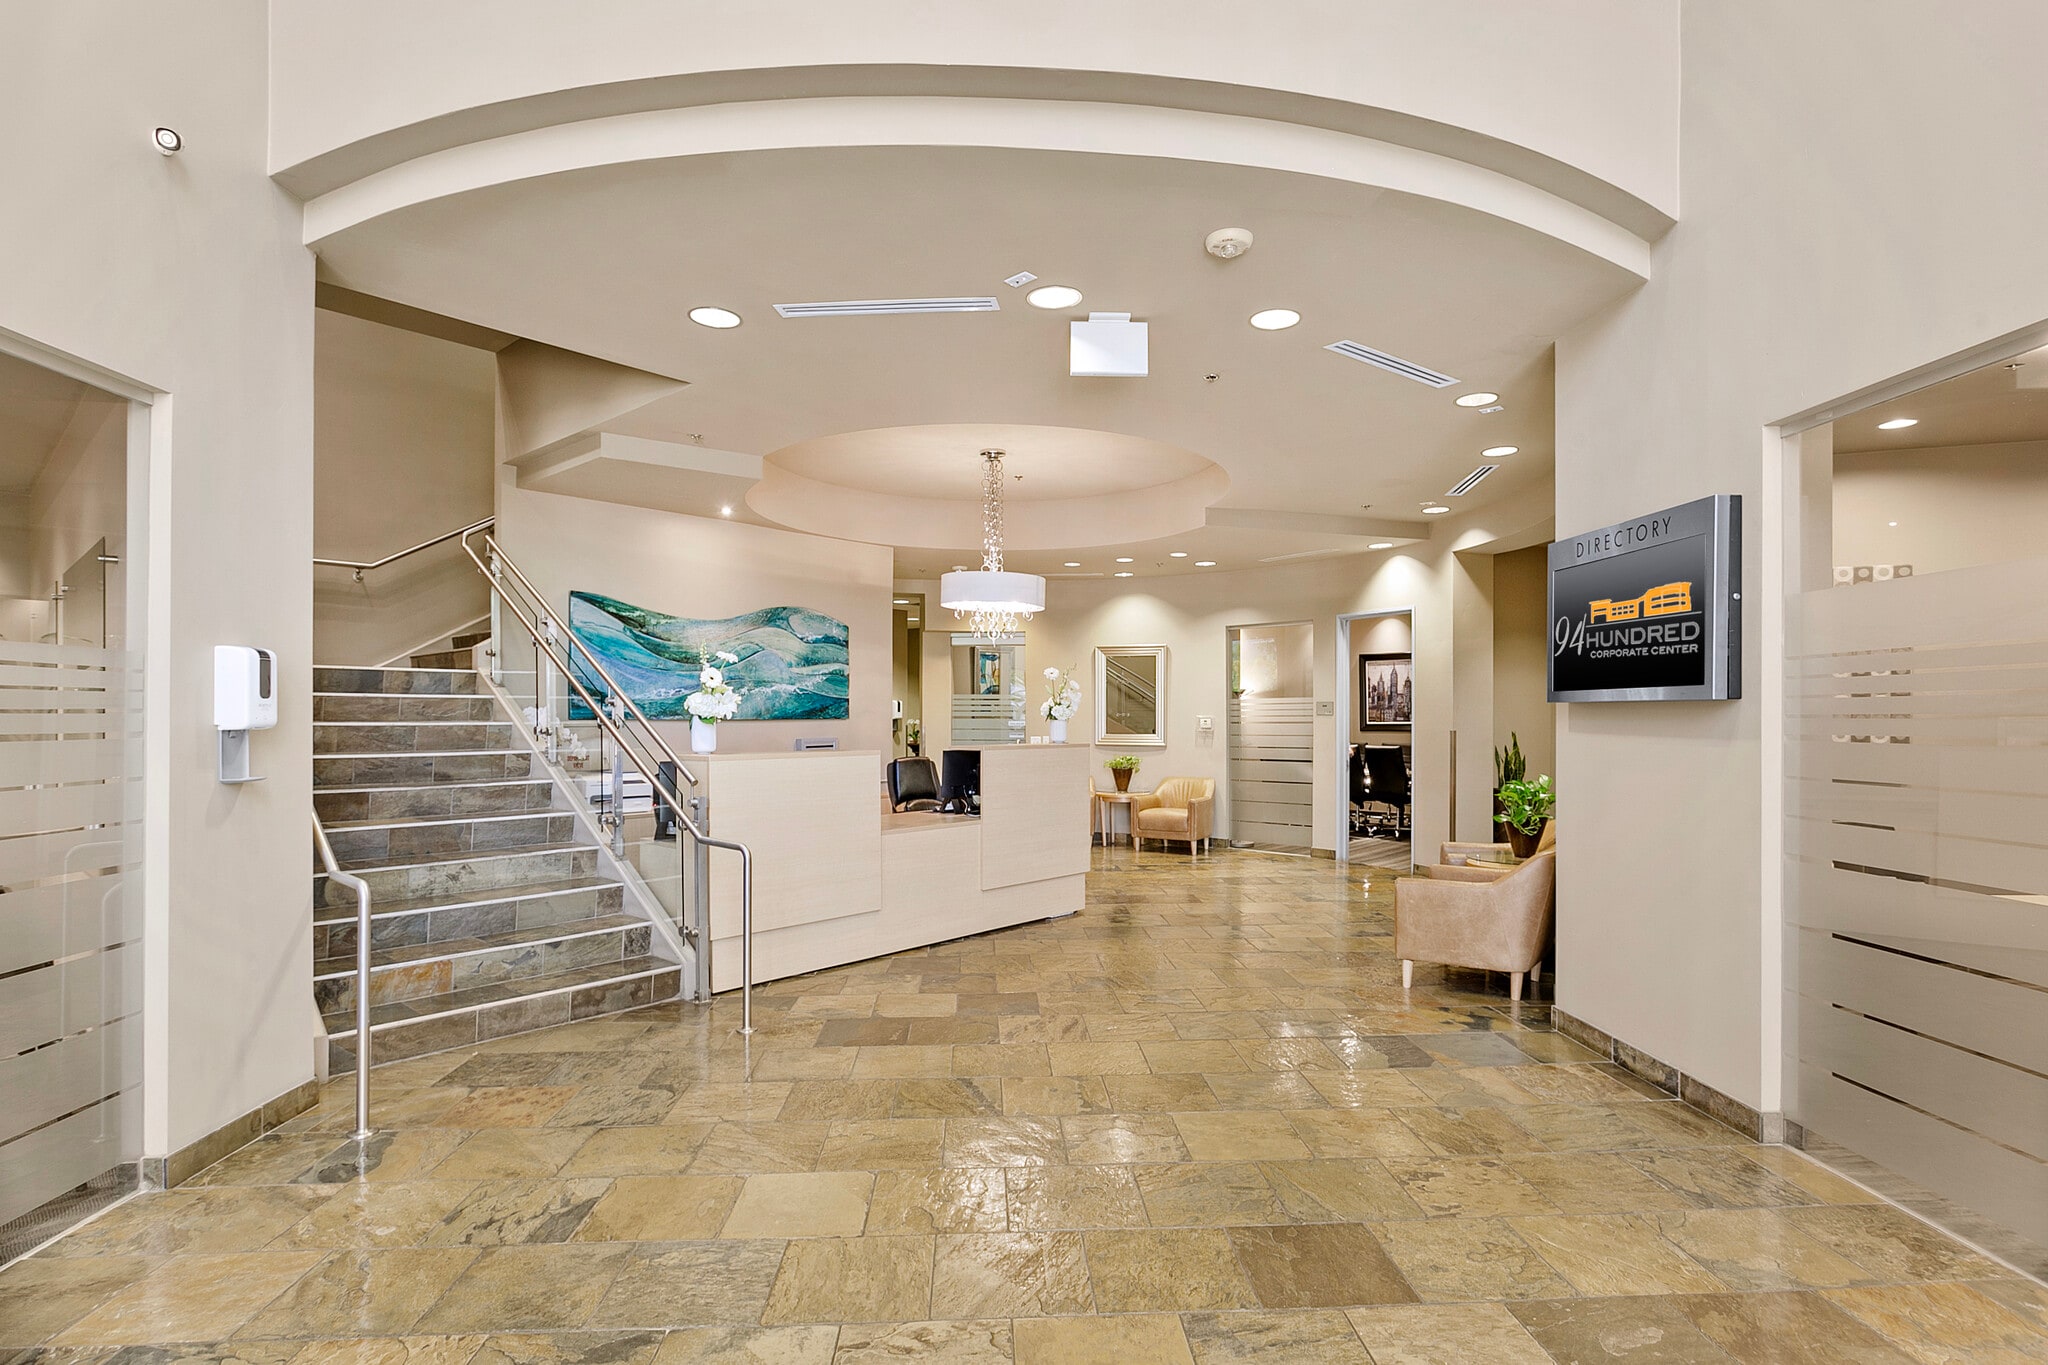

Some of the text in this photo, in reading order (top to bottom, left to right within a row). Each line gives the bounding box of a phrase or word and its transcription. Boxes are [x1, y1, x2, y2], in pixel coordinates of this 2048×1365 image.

[1576, 516, 1672, 558] DIRECTORY
[1555, 613, 1700, 657] 94 HUNDRED
[1590, 643, 1699, 659] CORPORATE CENTER
